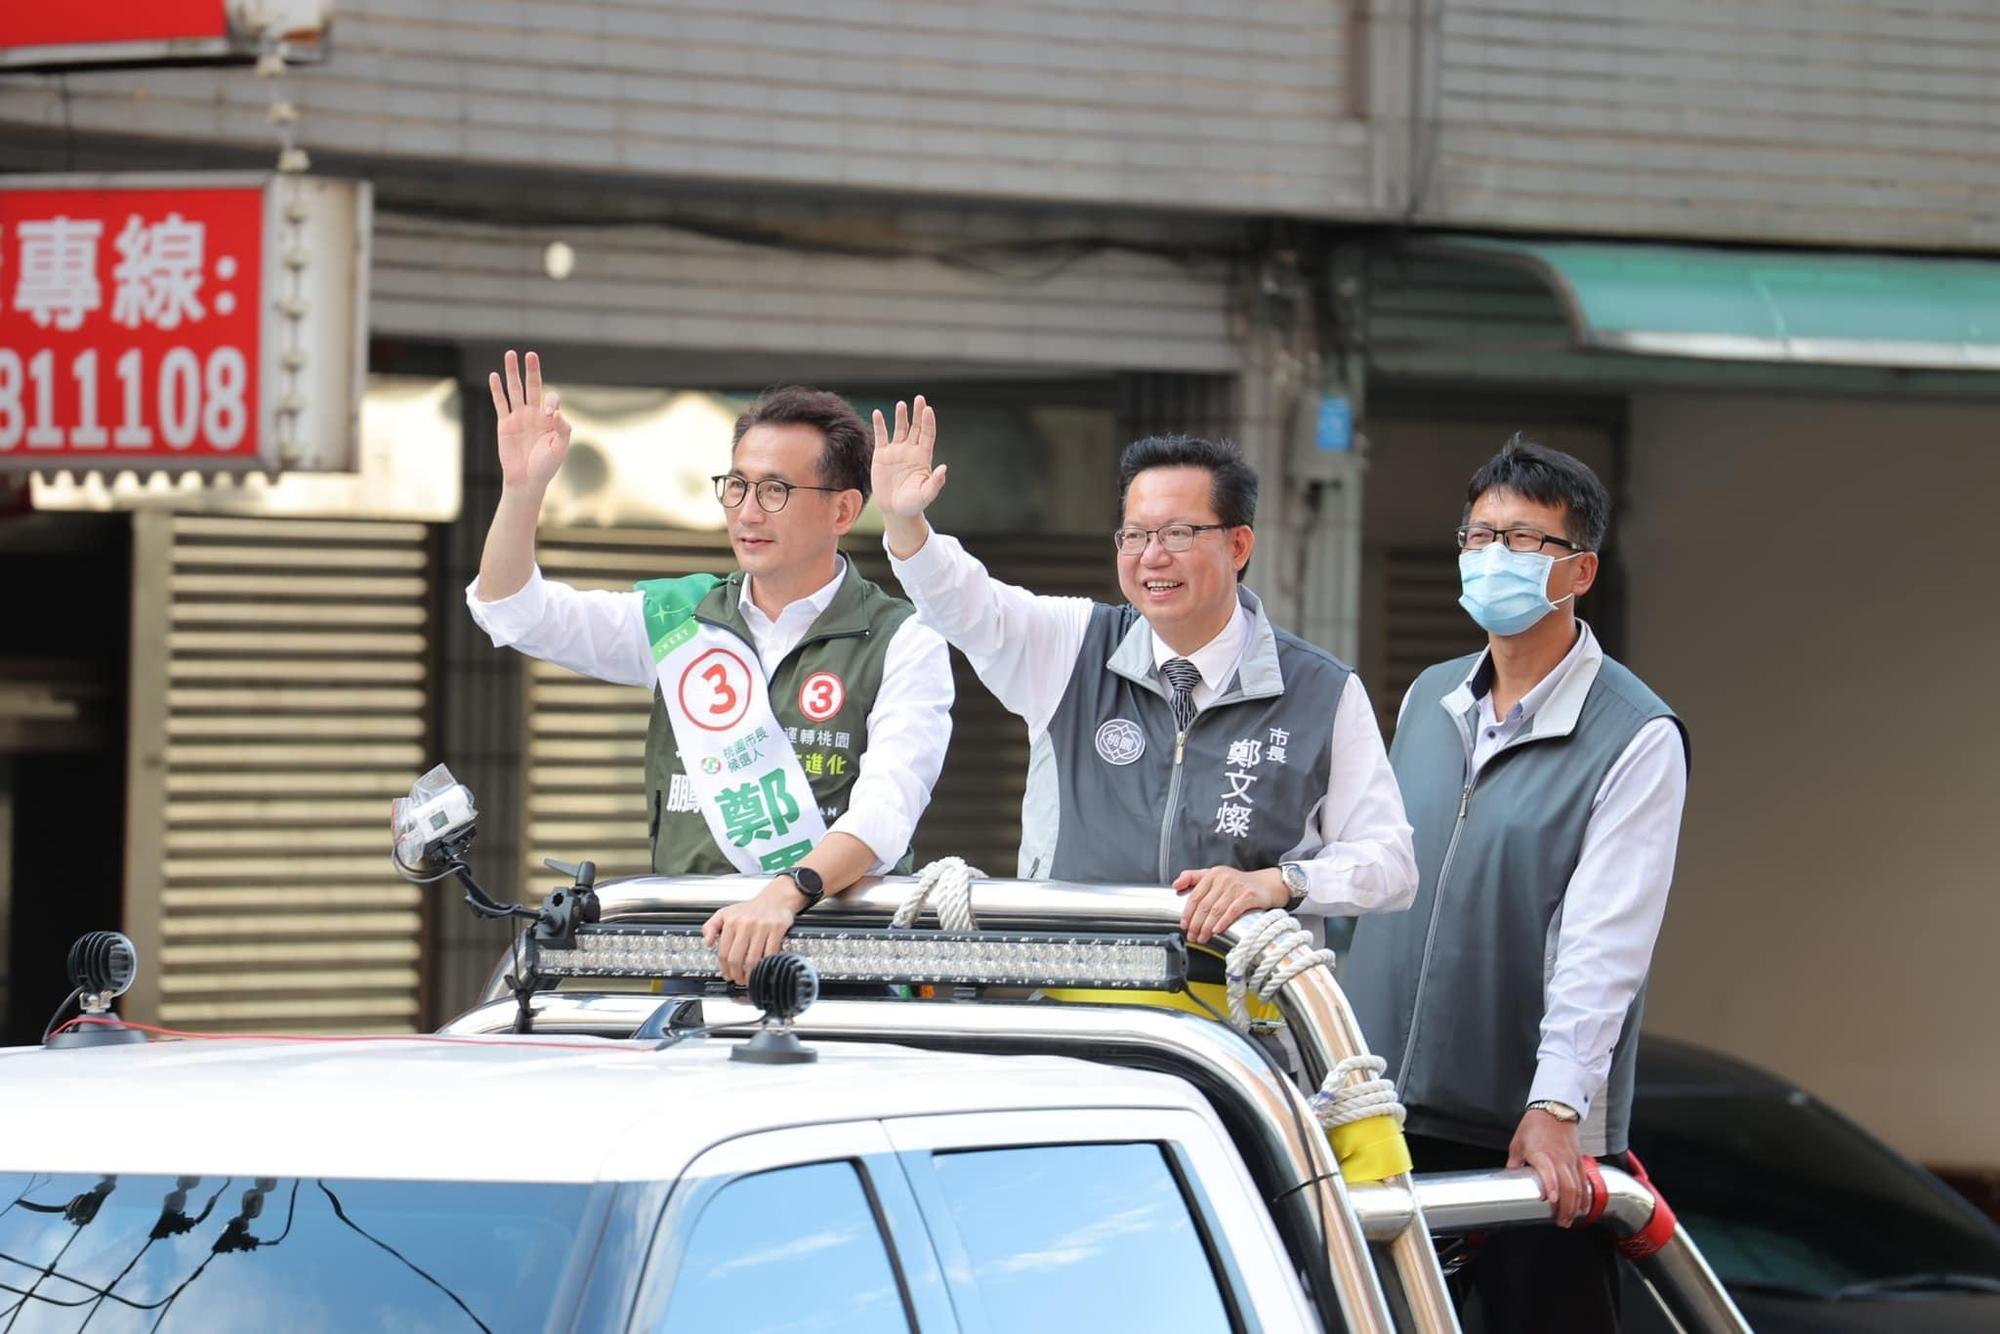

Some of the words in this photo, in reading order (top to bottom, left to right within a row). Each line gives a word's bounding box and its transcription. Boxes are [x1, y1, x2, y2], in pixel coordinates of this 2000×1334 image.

[0, 213, 237, 331] 專線:
[795, 752, 847, 775] 進化
[1266, 727, 1290, 764] 市長
[1215, 738, 1262, 838] 鄭文燦
